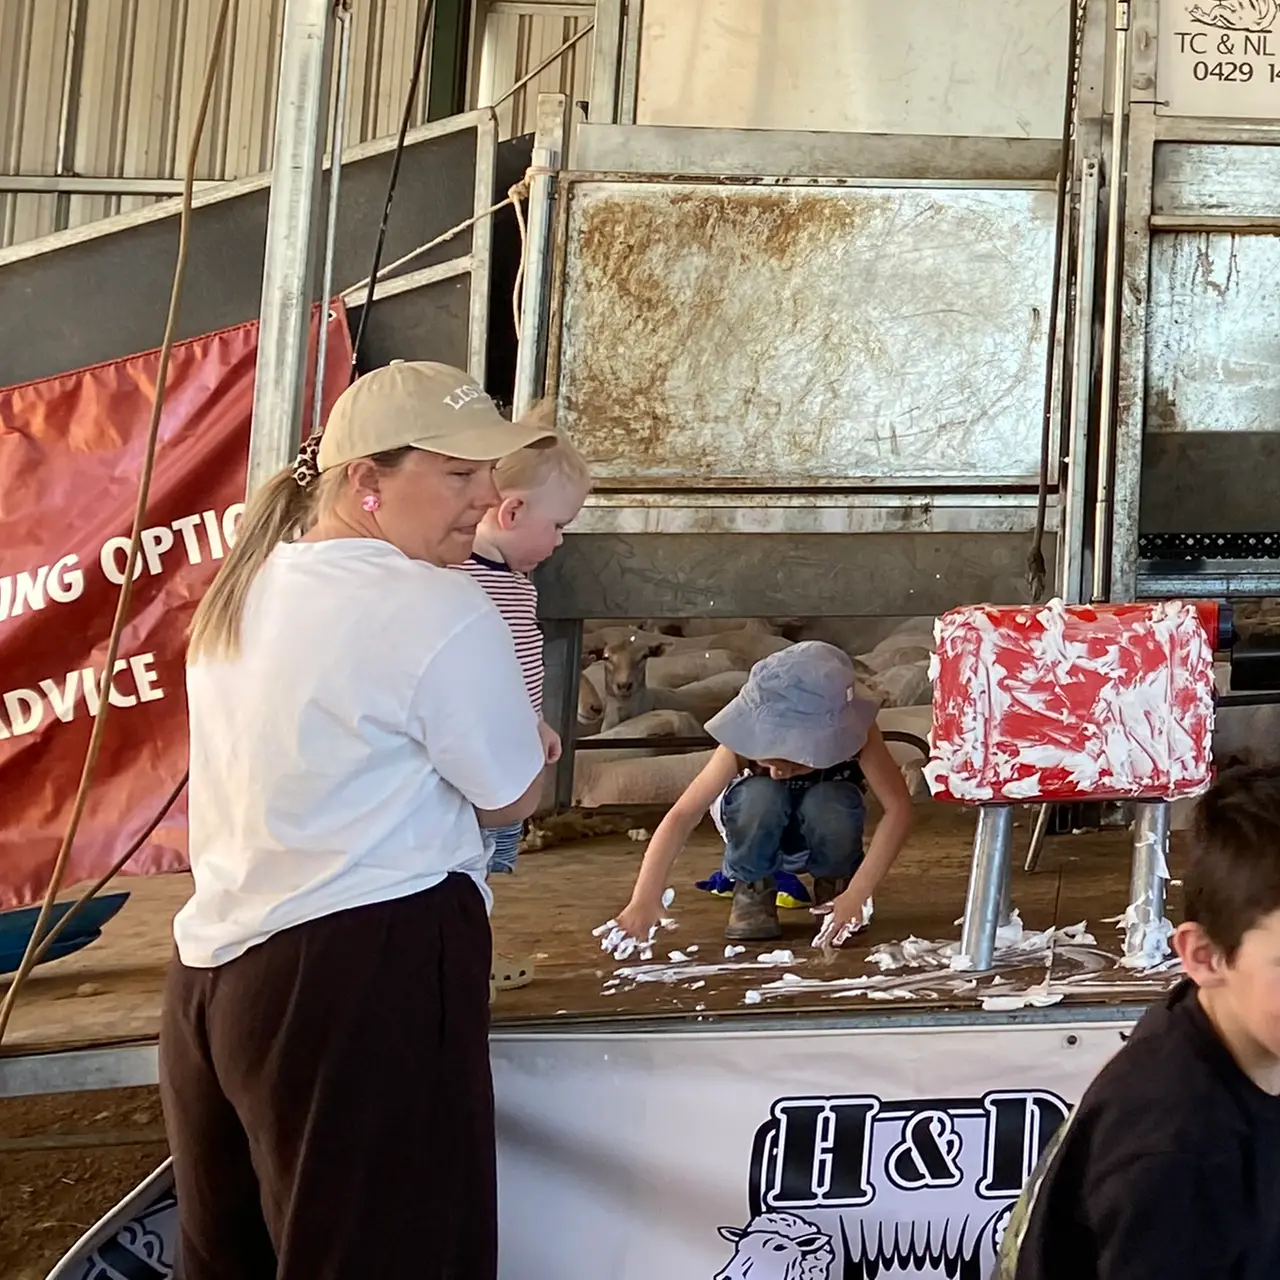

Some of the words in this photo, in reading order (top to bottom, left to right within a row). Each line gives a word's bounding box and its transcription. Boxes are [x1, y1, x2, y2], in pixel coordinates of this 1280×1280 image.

[1174, 32, 1207, 55] TC
[1217, 33, 1235, 55] &
[1244, 36, 1275, 57] NL
[1193, 61, 1253, 82] 0429
